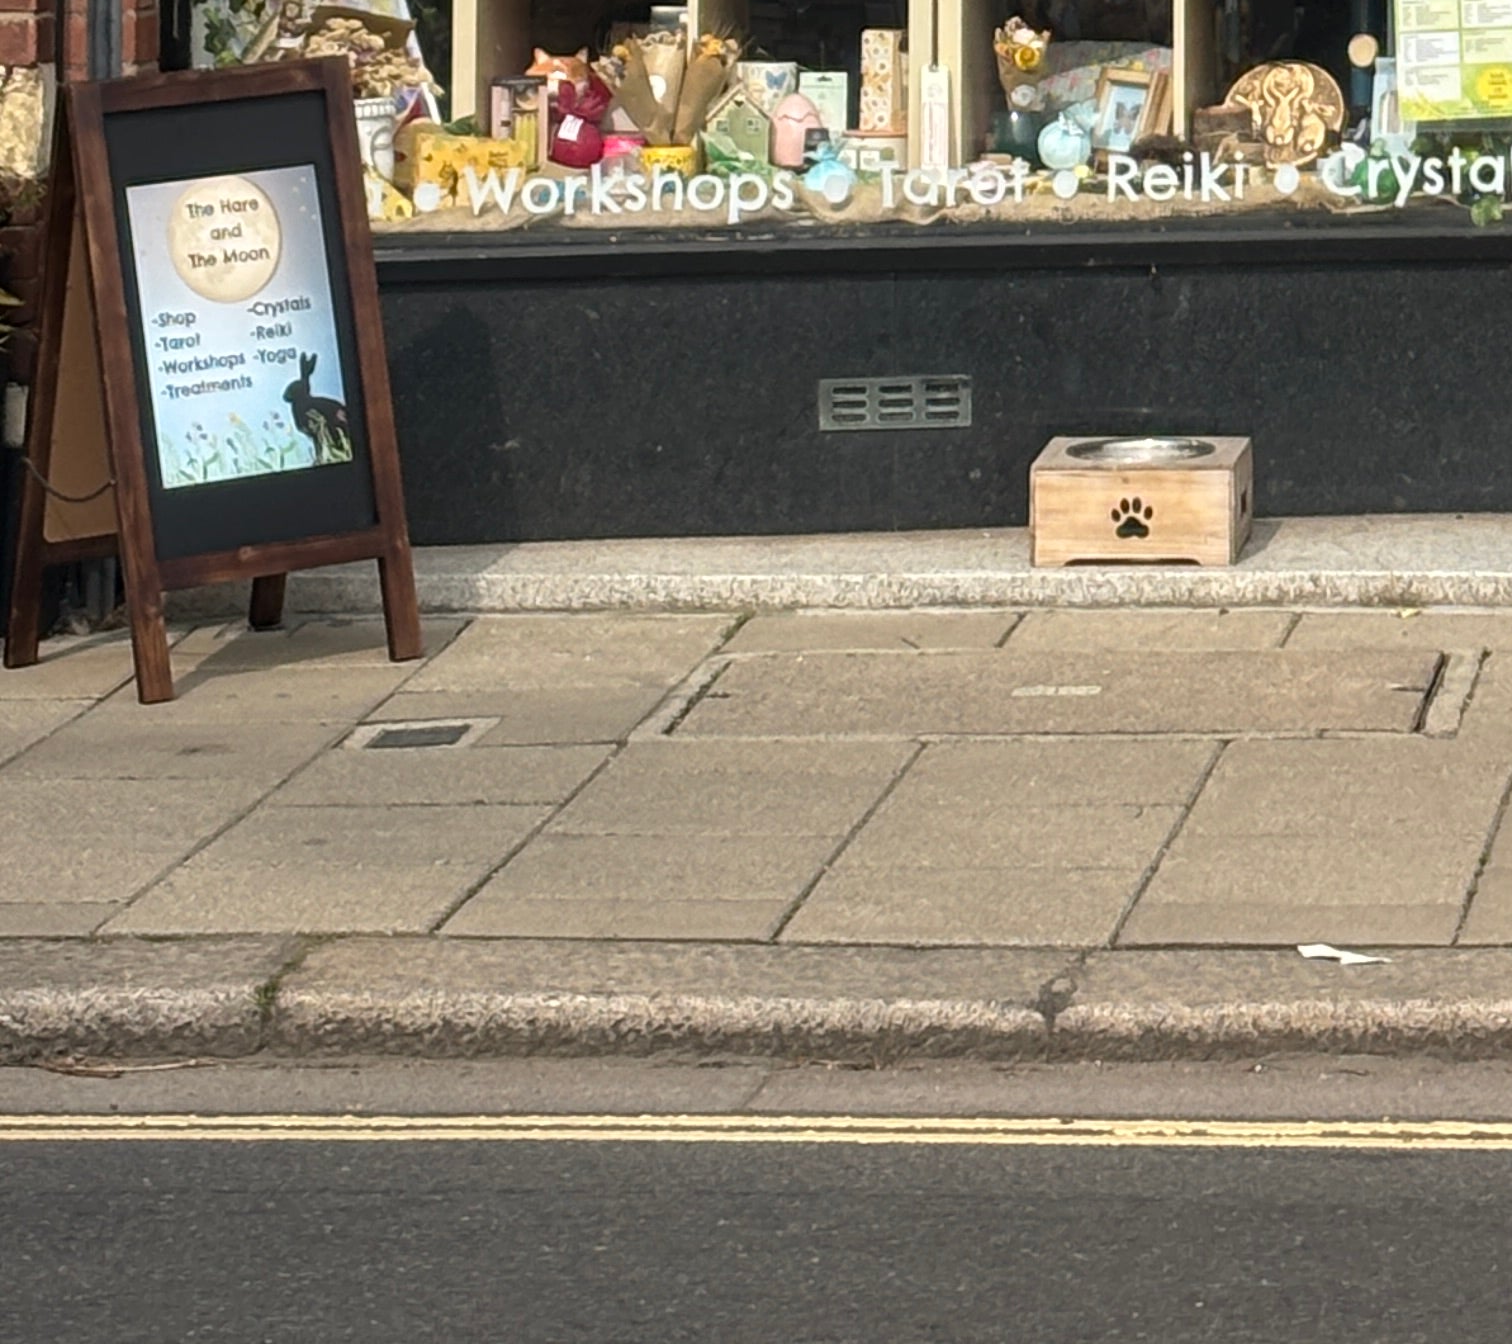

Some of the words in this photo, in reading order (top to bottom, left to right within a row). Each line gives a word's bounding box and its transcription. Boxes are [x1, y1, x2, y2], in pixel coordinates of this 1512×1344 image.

[463, 162, 794, 226] Workshops
[876, 156, 1031, 209] Tarot
[1106, 150, 1247, 203] Reiki
[185, 201, 215, 219] The
[219, 197, 260, 214] Hare
[209, 221, 243, 241] and
[187, 252, 218, 269] The
[222, 247, 271, 264] Moon
